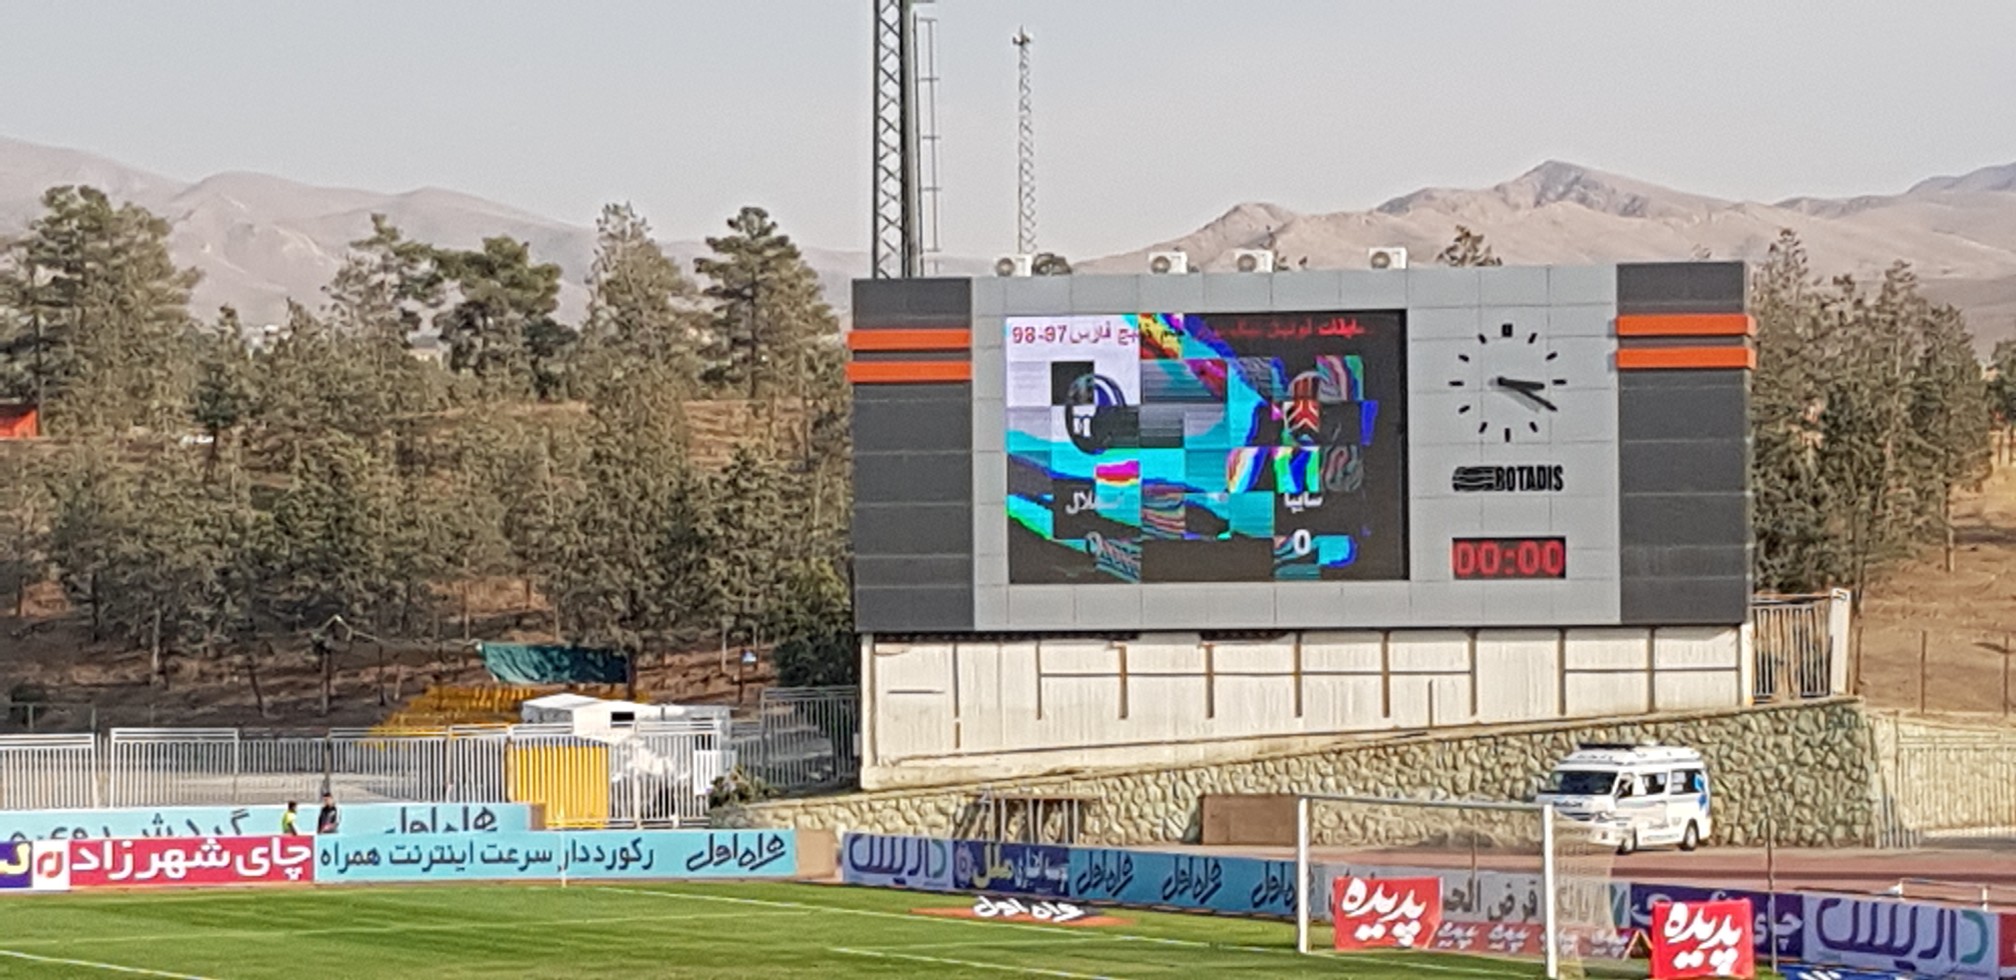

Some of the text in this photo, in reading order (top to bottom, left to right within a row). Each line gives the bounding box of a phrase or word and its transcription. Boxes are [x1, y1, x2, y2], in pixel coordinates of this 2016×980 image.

[1069, 321, 1112, 343] فارس
[1284, 491, 1323, 514] سایپا
[1455, 540, 1565, 576] 00:00
[71, 838, 231, 880] شهرزاد
[235, 837, 312, 881] چای
[319, 837, 655, 874] رکورددار سرعت اینترنت همراه
[1341, 876, 1428, 946] پدیده
[1486, 879, 1539, 922] قرض
[1664, 901, 1743, 976] پدیده
